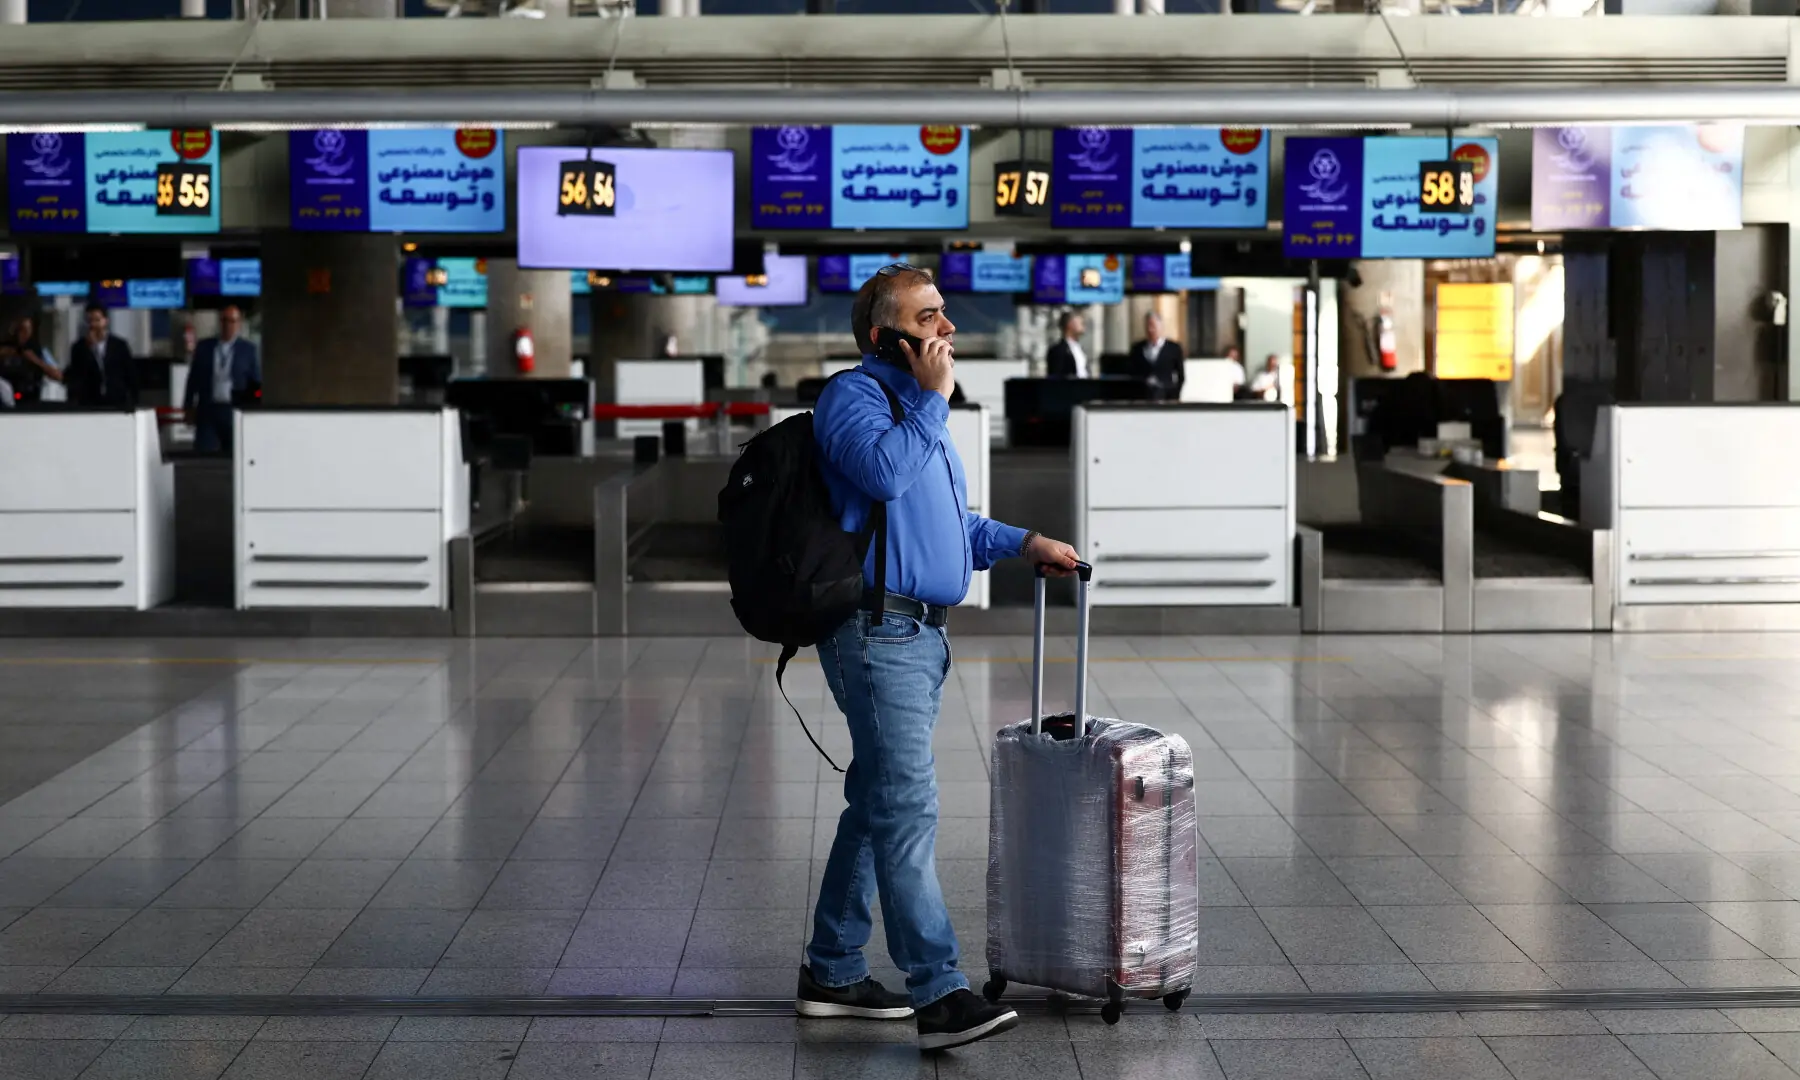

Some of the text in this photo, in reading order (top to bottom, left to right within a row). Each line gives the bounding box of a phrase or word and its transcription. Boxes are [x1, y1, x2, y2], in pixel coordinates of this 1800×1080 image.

[378, 162, 495, 185] هوش مصنوعی
[842, 159, 959, 181] هوش مصنوعی
[1142, 158, 1259, 181] هوش مصنوعی
[157, 173, 174, 206] 55
[178, 173, 210, 207] 55
[378, 184, 494, 213] و توسعه
[560, 171, 588, 206] 56
[593, 171, 615, 208] 56
[842, 181, 958, 209] و توسعه
[996, 171, 1021, 207] 57
[1025, 171, 1050, 206] 57
[1142, 180, 1258, 208] و توسعه
[1421, 170, 1456, 206] 58
